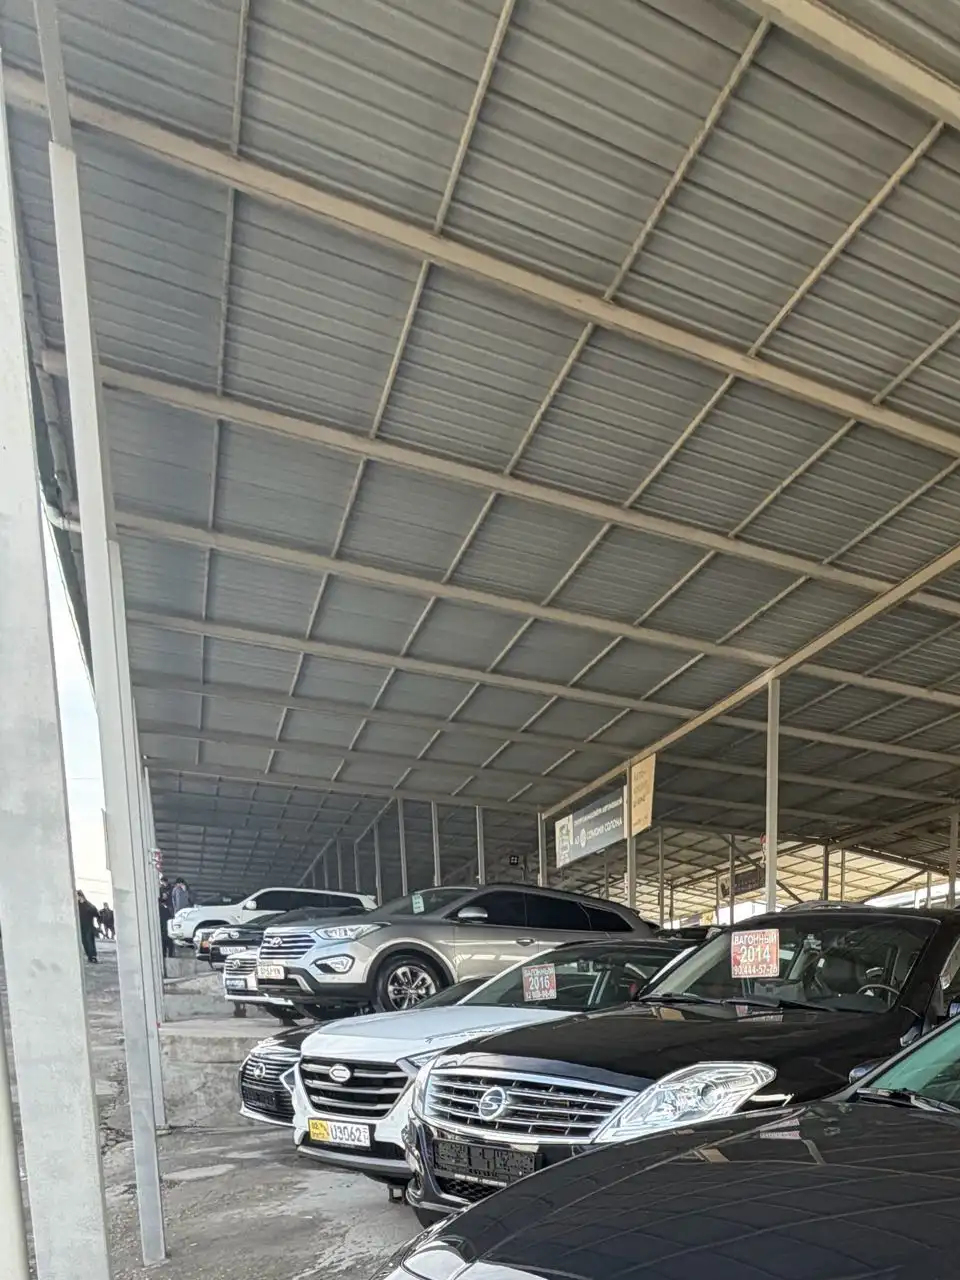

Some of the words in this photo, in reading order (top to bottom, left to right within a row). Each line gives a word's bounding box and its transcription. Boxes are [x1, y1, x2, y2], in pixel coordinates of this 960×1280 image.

[734, 932, 777, 945] ВАГОННЫЙ
[740, 944, 771, 963] 2014
[528, 974, 550, 991] 2016
[331, 1124, 363, 1142] U3062
